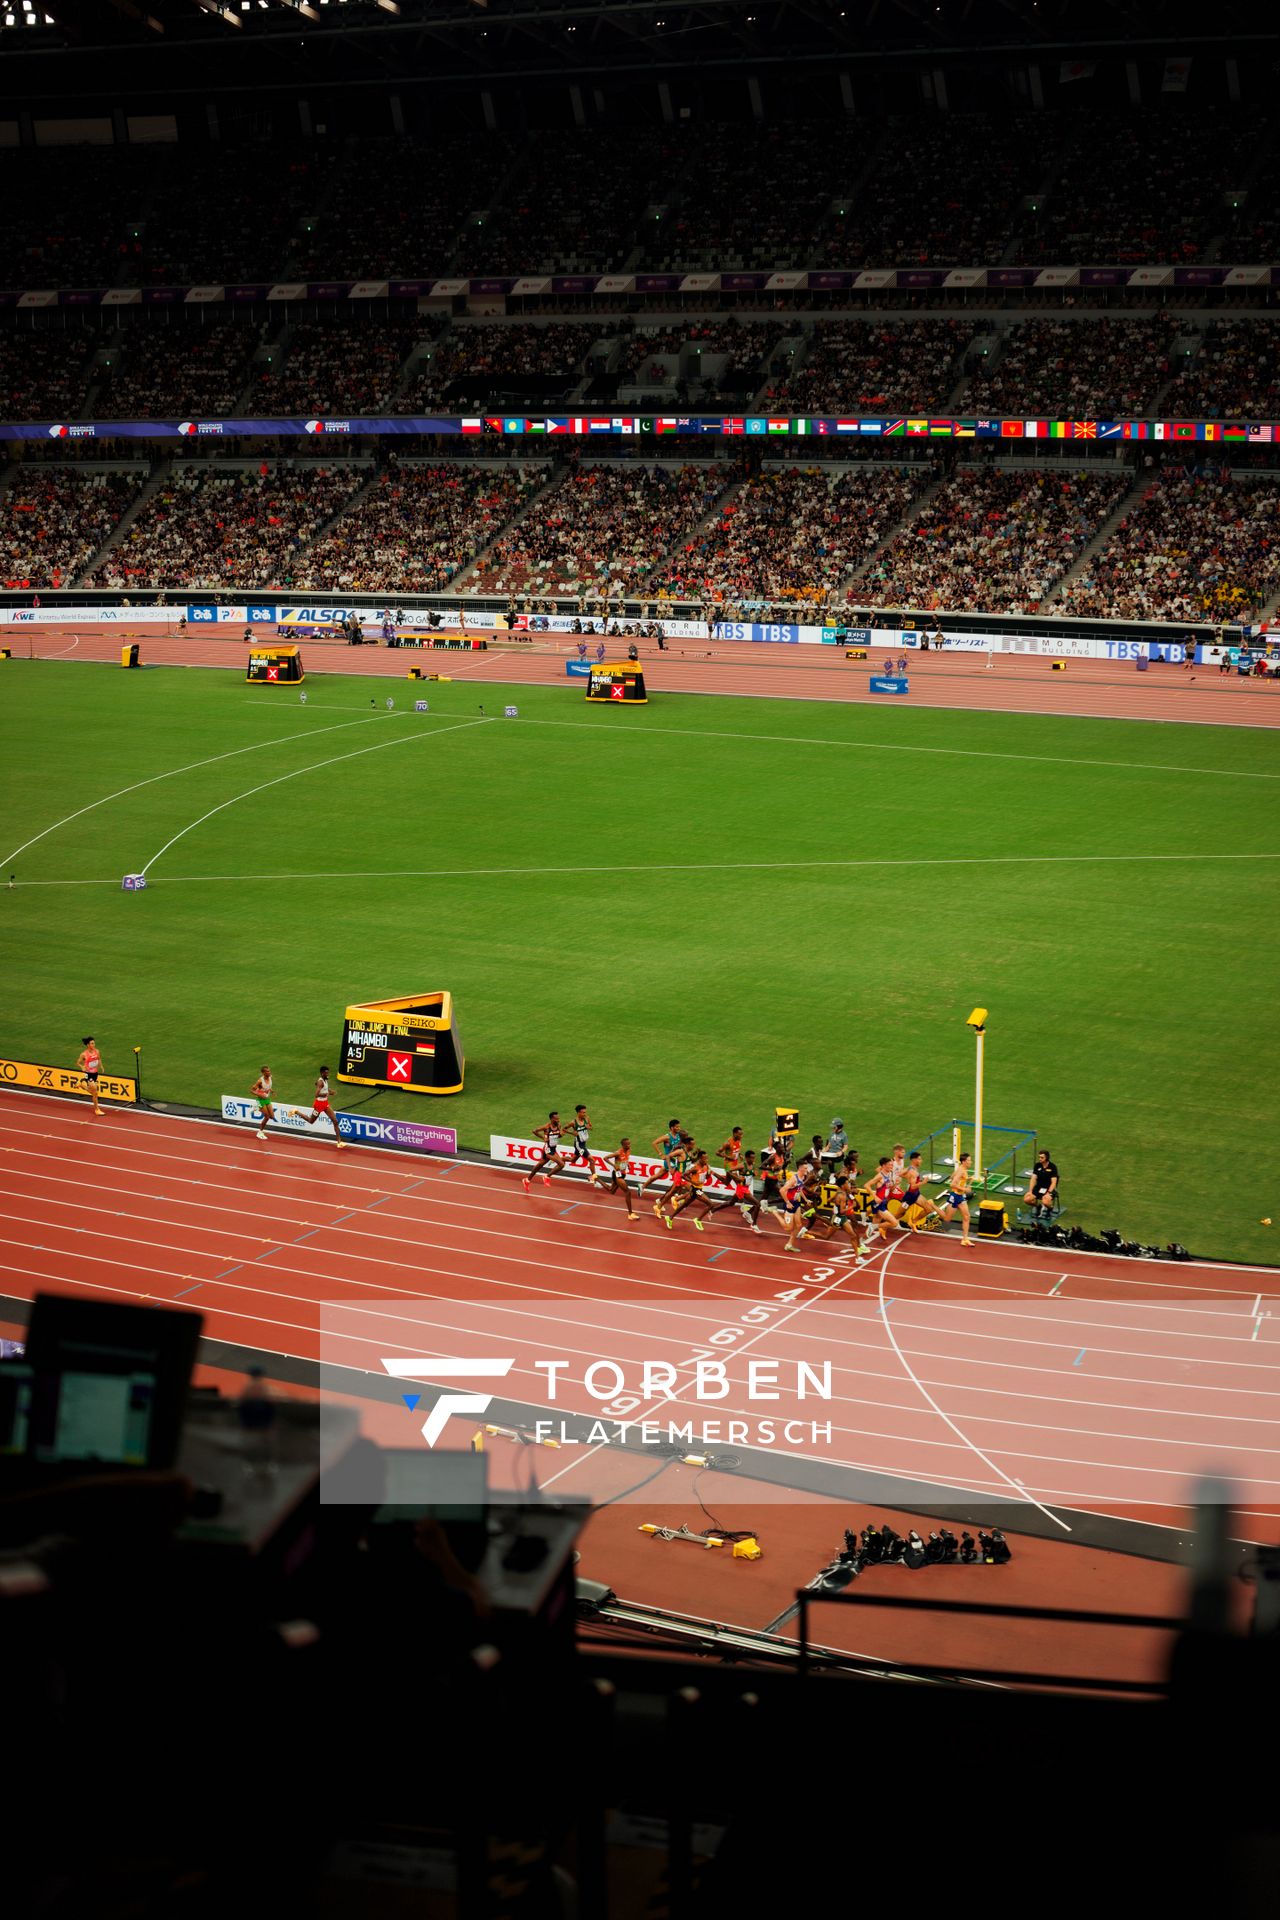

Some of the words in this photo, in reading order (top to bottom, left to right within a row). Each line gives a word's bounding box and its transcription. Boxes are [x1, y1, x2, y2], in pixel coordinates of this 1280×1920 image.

[12, 611, 35, 621] KWE
[760, 624, 792, 642] TBS
[1042, 640, 1089, 648] MORI
[1042, 647, 1090, 655] BUILDING
[1105, 642, 1140, 659] TBS
[506, 708, 517, 716] 65
[135, 878, 146, 888] 65
[348, 1020, 365, 1031] LONG
[366, 1022, 384, 1033] JUMP
[386, 1025, 392, 1034] W
[393, 1026, 410, 1036] FINAL
[402, 1017, 436, 1029] SEIKO
[348, 1030, 388, 1048] MIHAMBO
[60, 1074, 130, 1097] PRPEX
[281, 1117, 307, 1127] Better
[351, 1119, 396, 1141] TDK
[396, 1125, 406, 1135] In
[405, 1127, 455, 1143] Everything,
[397, 1133, 425, 1145] Better
[506, 1143, 610, 1172] HODA
[802, 1267, 836, 1282] 3
[773, 1287, 806, 1303] 4
[740, 1305, 779, 1323] 5
[708, 1327, 745, 1345] 6
[676, 1348, 717, 1367] 7
[601, 1396, 642, 1416] 9
